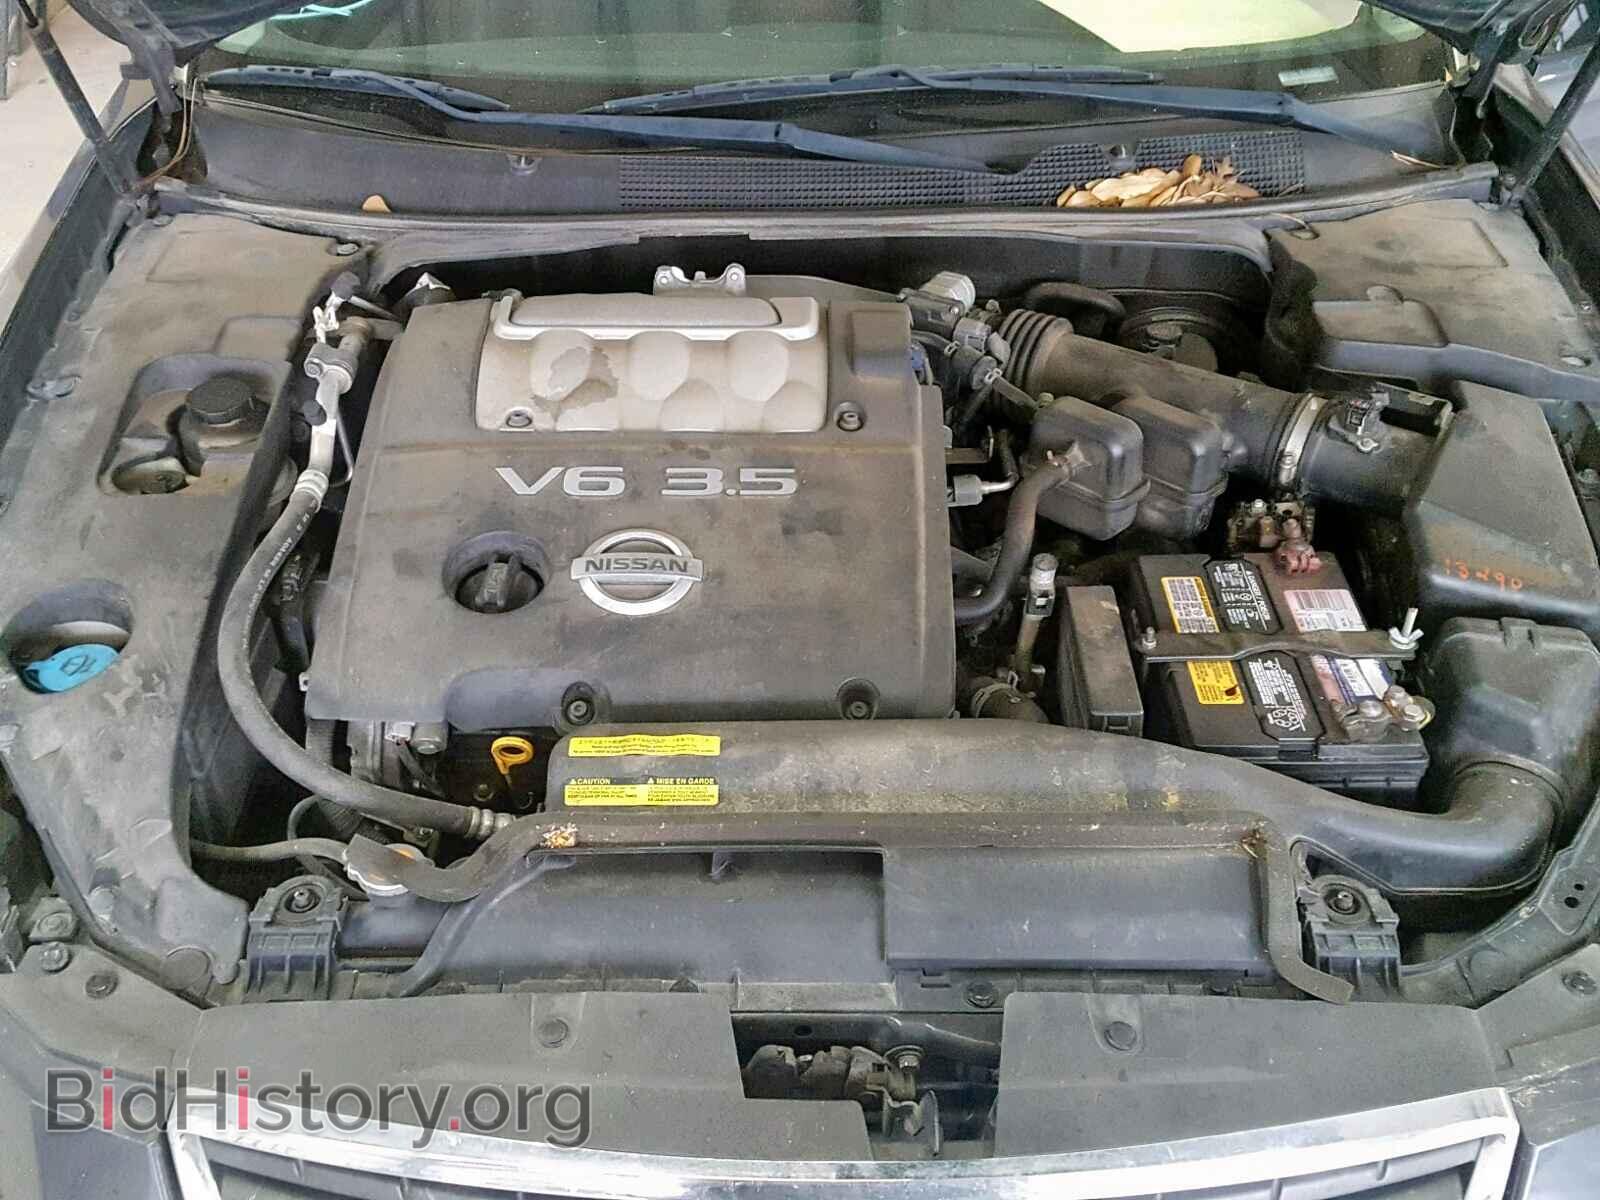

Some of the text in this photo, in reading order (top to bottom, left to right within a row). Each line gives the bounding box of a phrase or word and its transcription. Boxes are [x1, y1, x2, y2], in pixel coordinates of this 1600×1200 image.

[495, 466, 798, 497] V6 3.5
[584, 557, 689, 573] NISSAN
